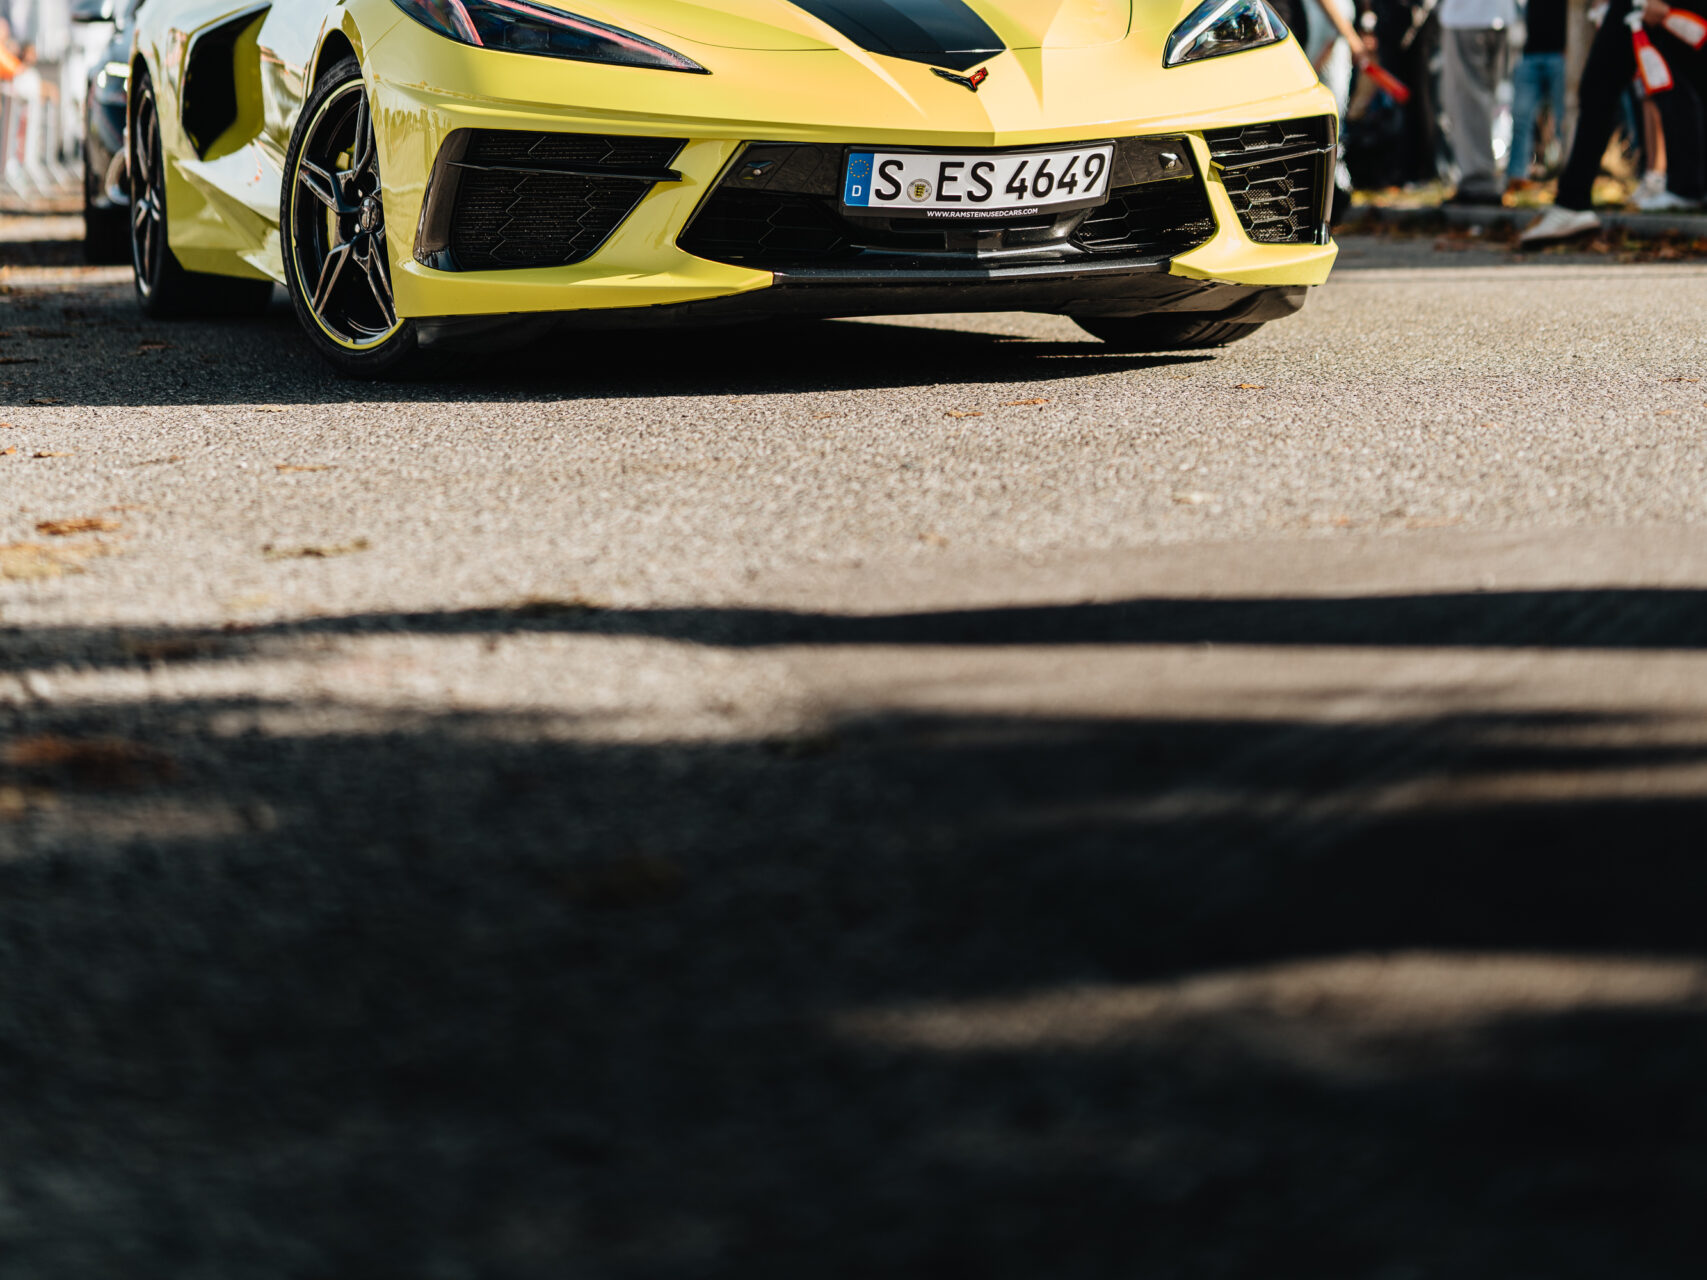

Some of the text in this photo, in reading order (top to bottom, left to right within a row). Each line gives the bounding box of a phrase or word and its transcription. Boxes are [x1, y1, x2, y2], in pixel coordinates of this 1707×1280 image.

[874, 153, 1106, 202] S ES 4649
[851, 185, 861, 197] D
[926, 207, 1039, 218] WWW.RAMSTEINUSEDCARS.COM
